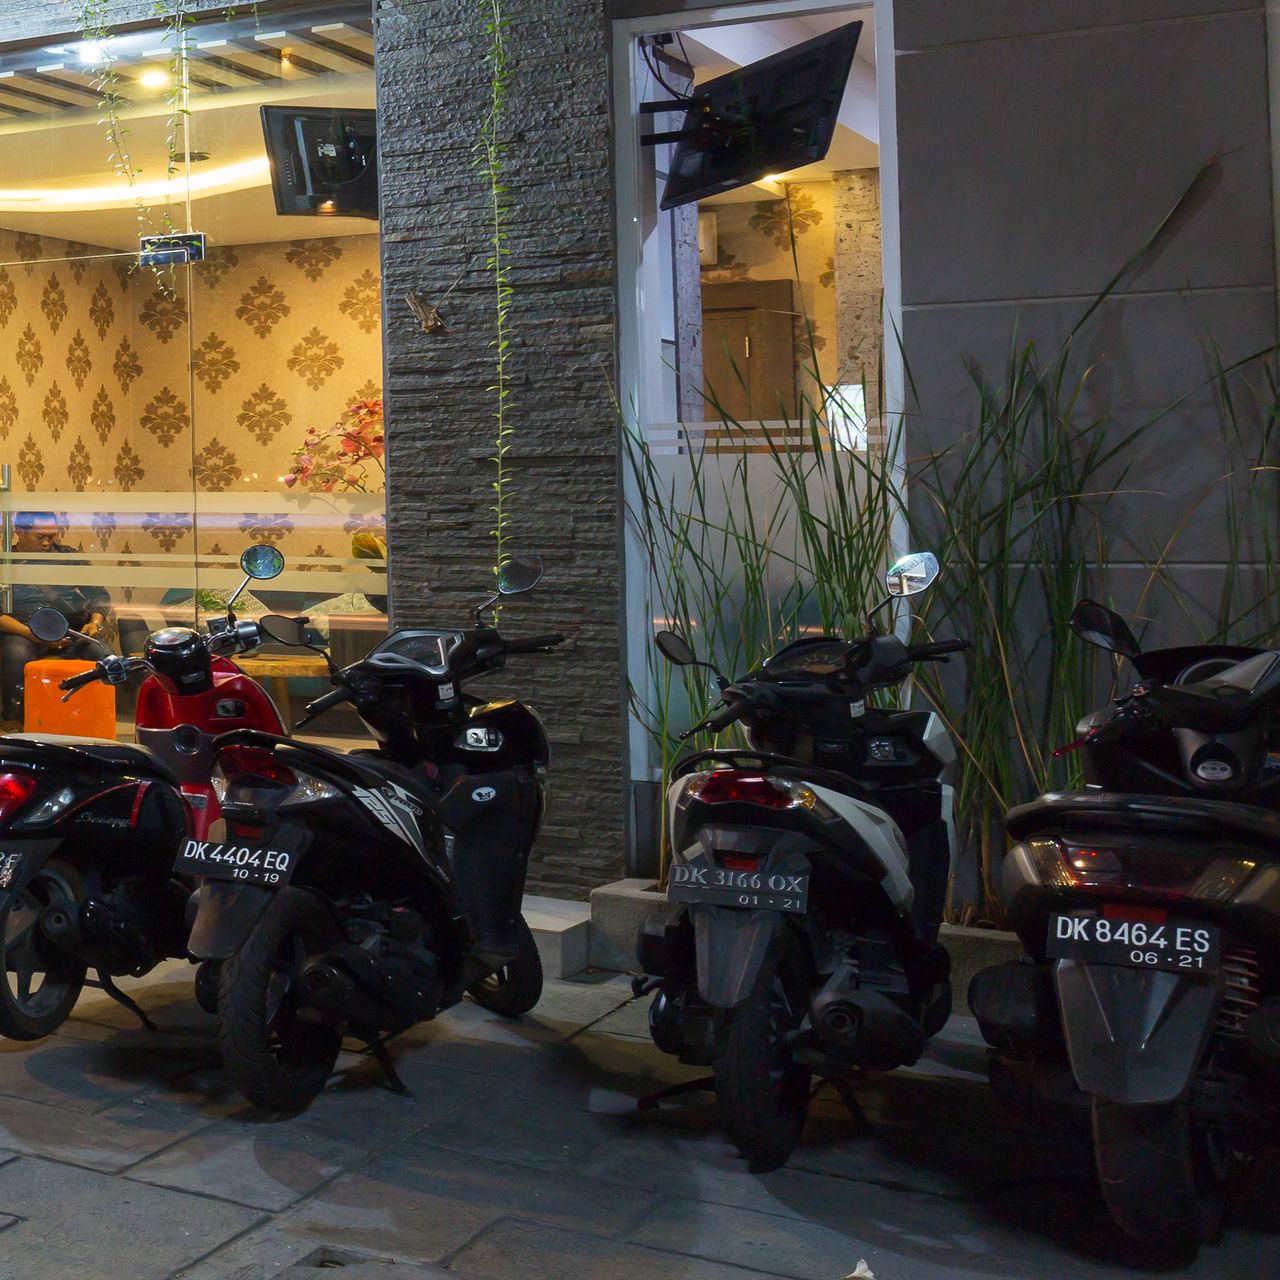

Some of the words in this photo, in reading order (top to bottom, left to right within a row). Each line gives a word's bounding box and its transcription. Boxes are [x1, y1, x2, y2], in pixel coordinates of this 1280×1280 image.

[183, 840, 209, 860] DK
[210, 845, 262, 867] 4404
[263, 850, 290, 872] EQ
[674, 865, 709, 885] DK
[714, 870, 761, 889] 3166
[768, 874, 803, 893] OX
[1056, 916, 1090, 942] DK
[1095, 919, 1168, 949] 8464
[1176, 927, 1210, 953] ES
